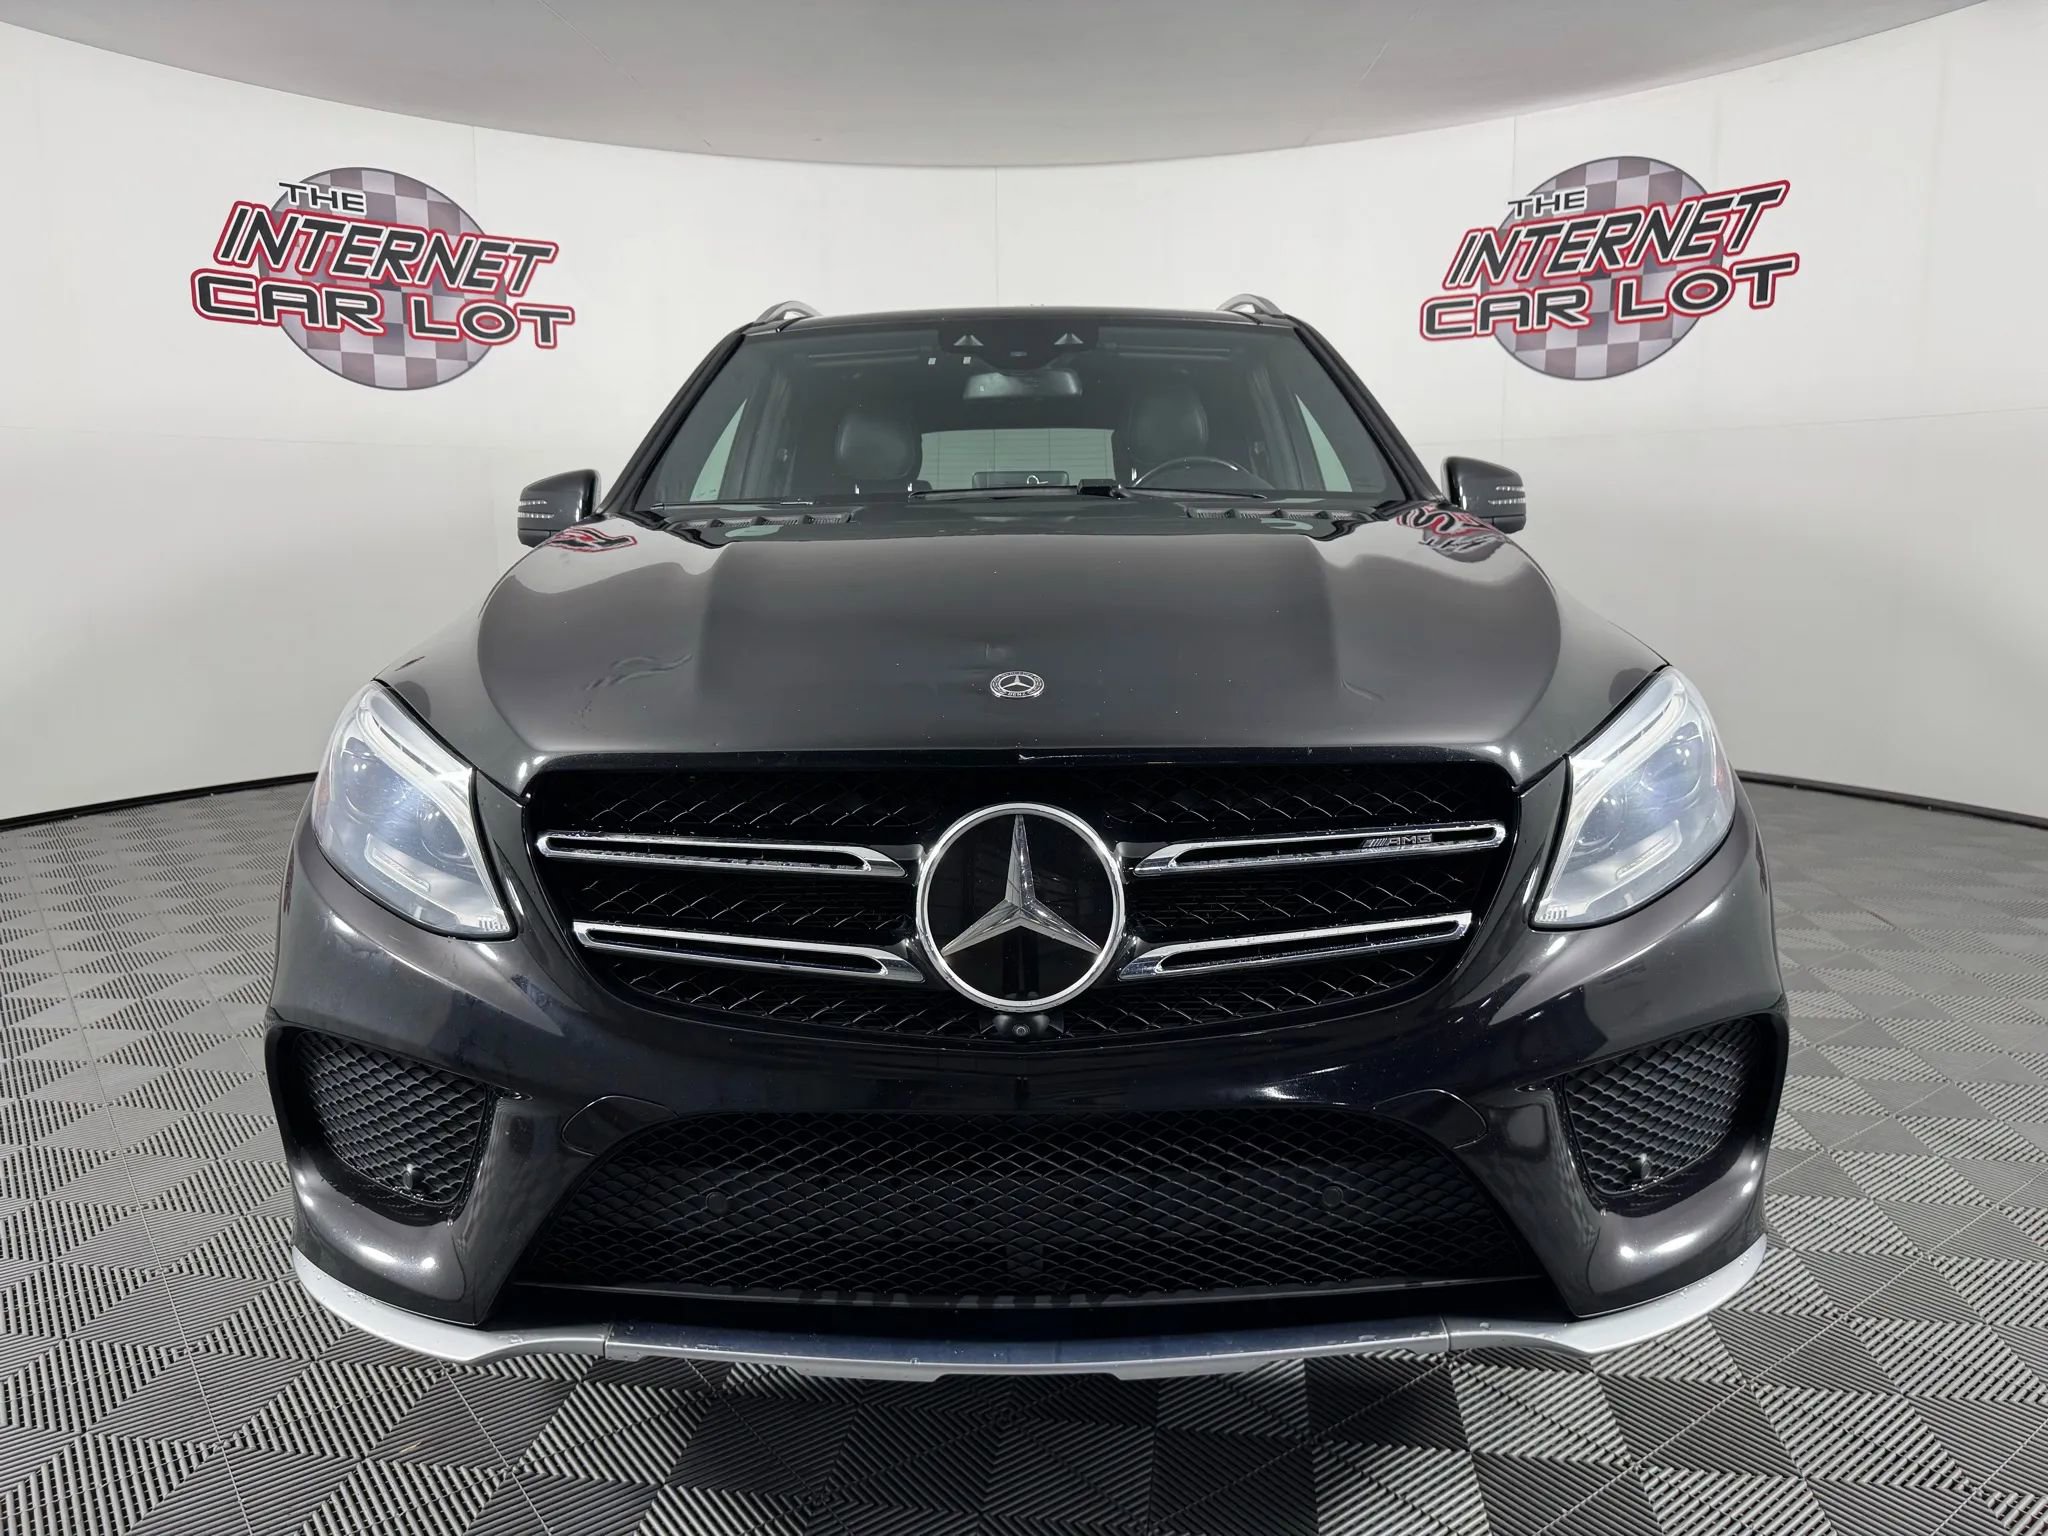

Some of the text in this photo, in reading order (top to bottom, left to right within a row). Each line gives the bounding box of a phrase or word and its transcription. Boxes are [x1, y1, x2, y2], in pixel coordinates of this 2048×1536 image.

[279, 182, 366, 214] THE
[1443, 180, 1789, 289] INTERNET
[1508, 187, 1587, 219] THE
[215, 201, 558, 296] INTERNET
[192, 269, 574, 348] CAR LOT
[1421, 254, 1798, 340] CAR LOT
[1387, 833, 1432, 846] AMG
